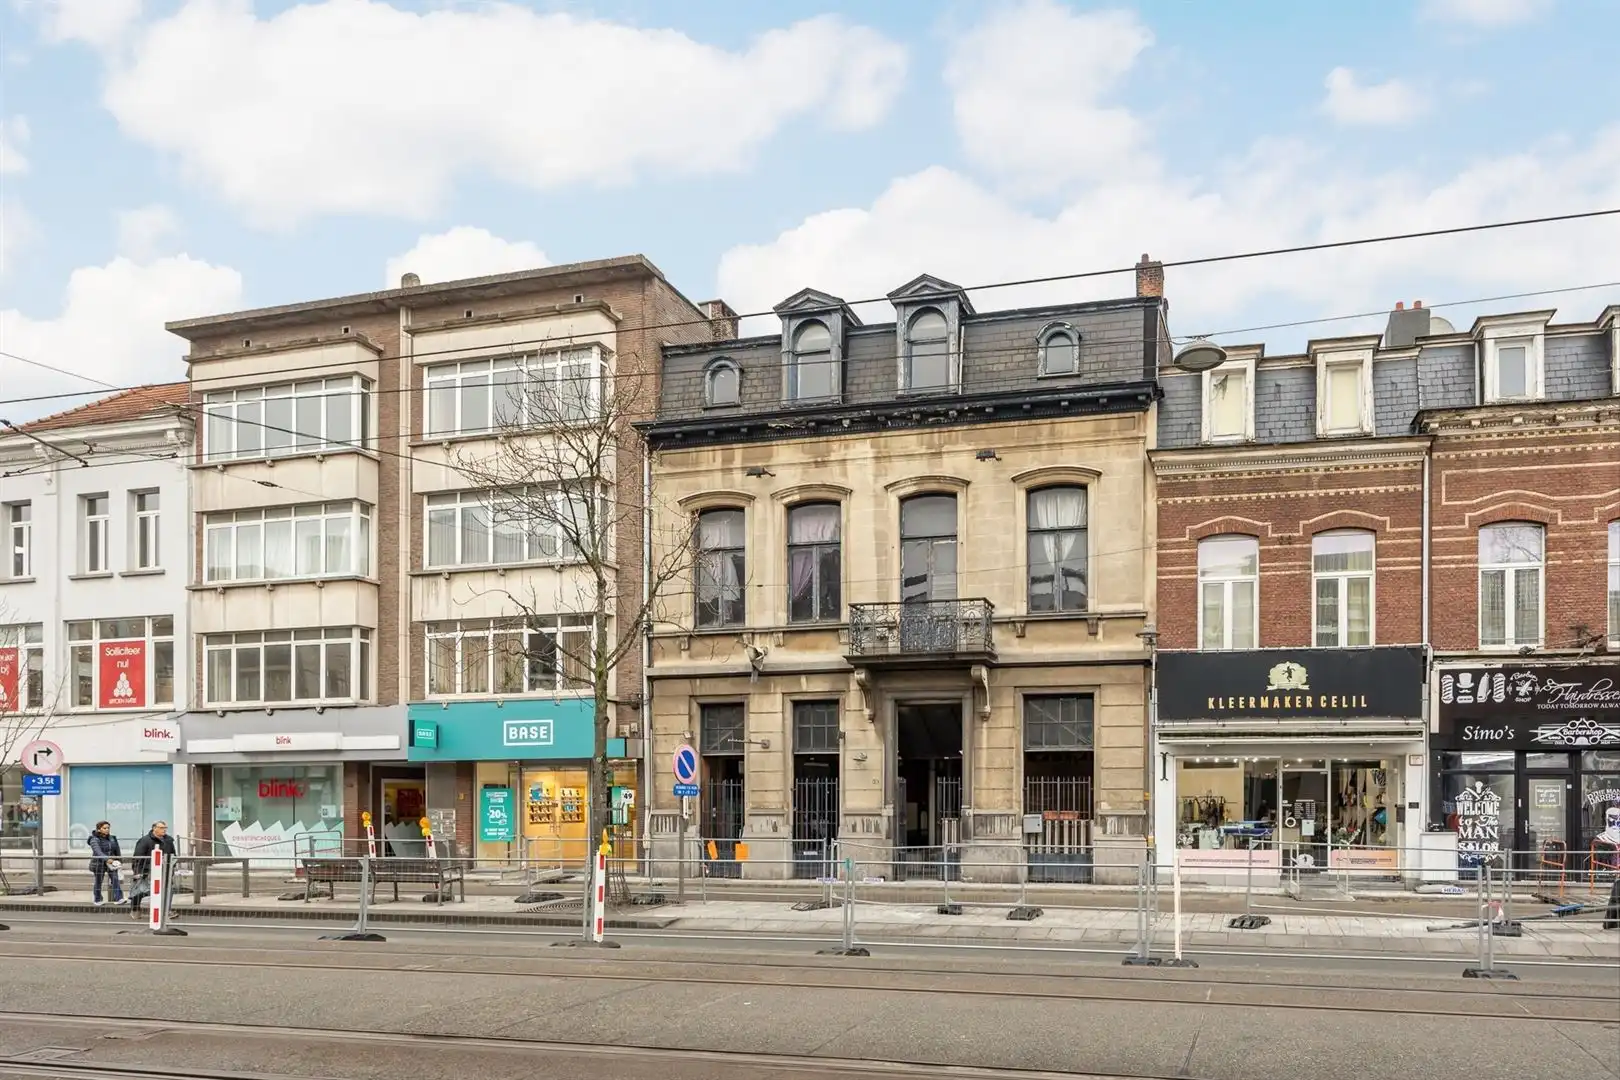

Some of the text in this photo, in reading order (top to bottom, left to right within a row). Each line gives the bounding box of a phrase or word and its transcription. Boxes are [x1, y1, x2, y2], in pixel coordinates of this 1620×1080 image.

[105, 646, 141, 656] Solliciteer
[1208, 695, 1368, 709] KLEERMAKER CELIL
[144, 728, 174, 739] blink.
[508, 726, 548, 739] BASE
[1562, 728, 1603, 737] Barbershop
[276, 736, 292, 744] blink
[107, 801, 141, 810] konvert
[1456, 801, 1500, 815] WELCOME
[1459, 815, 1498, 827] to The
[1458, 826, 1499, 839] MAN
[1458, 842, 1499, 851] SALON
